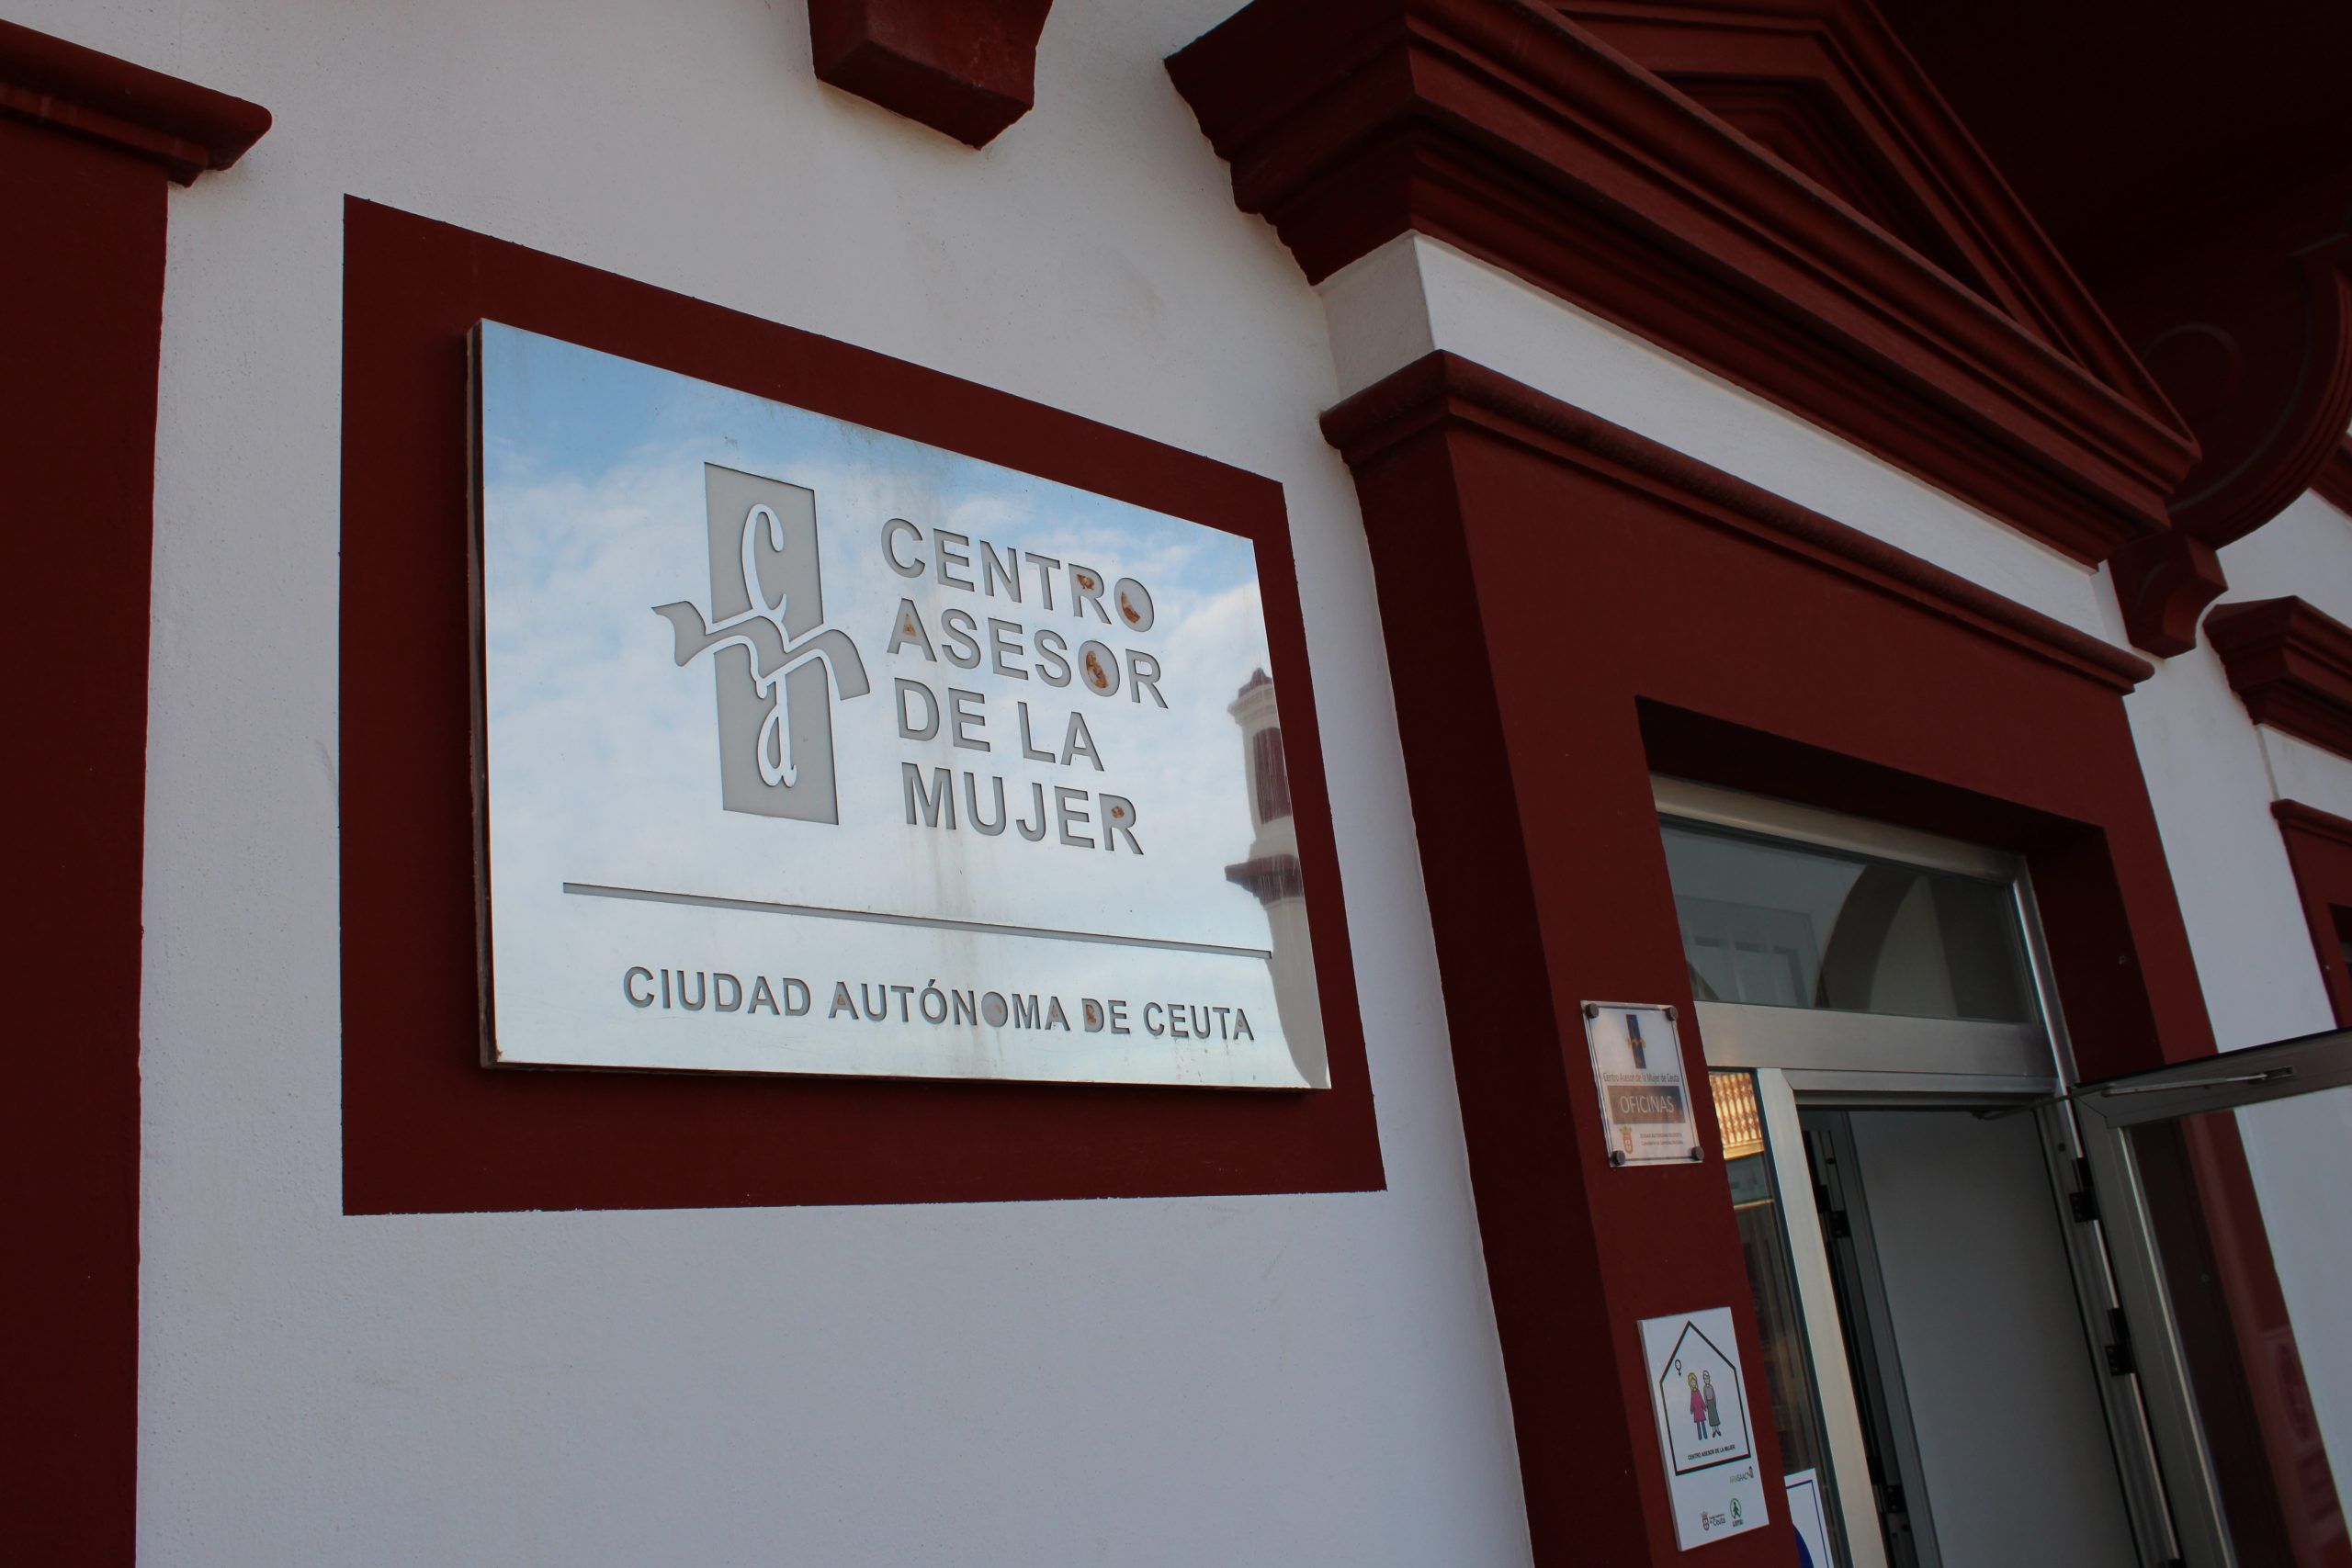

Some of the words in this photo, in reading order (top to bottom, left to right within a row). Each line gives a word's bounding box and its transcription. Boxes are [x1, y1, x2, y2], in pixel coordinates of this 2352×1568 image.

[880, 518, 1154, 632] CENTRO
[887, 597, 1169, 709] ASESOR
[894, 677, 991, 752] DE
[1016, 701, 1105, 772] LA
[901, 761, 1145, 855] MUJER
[623, 965, 812, 1017] CIUDAD
[828, 978, 1071, 1032] AUTÓNOMA
[1080, 998, 1131, 1034] DE
[1142, 1001, 1255, 1041] CEUTA
[1620, 1095, 1675, 1113] OFICINAS
